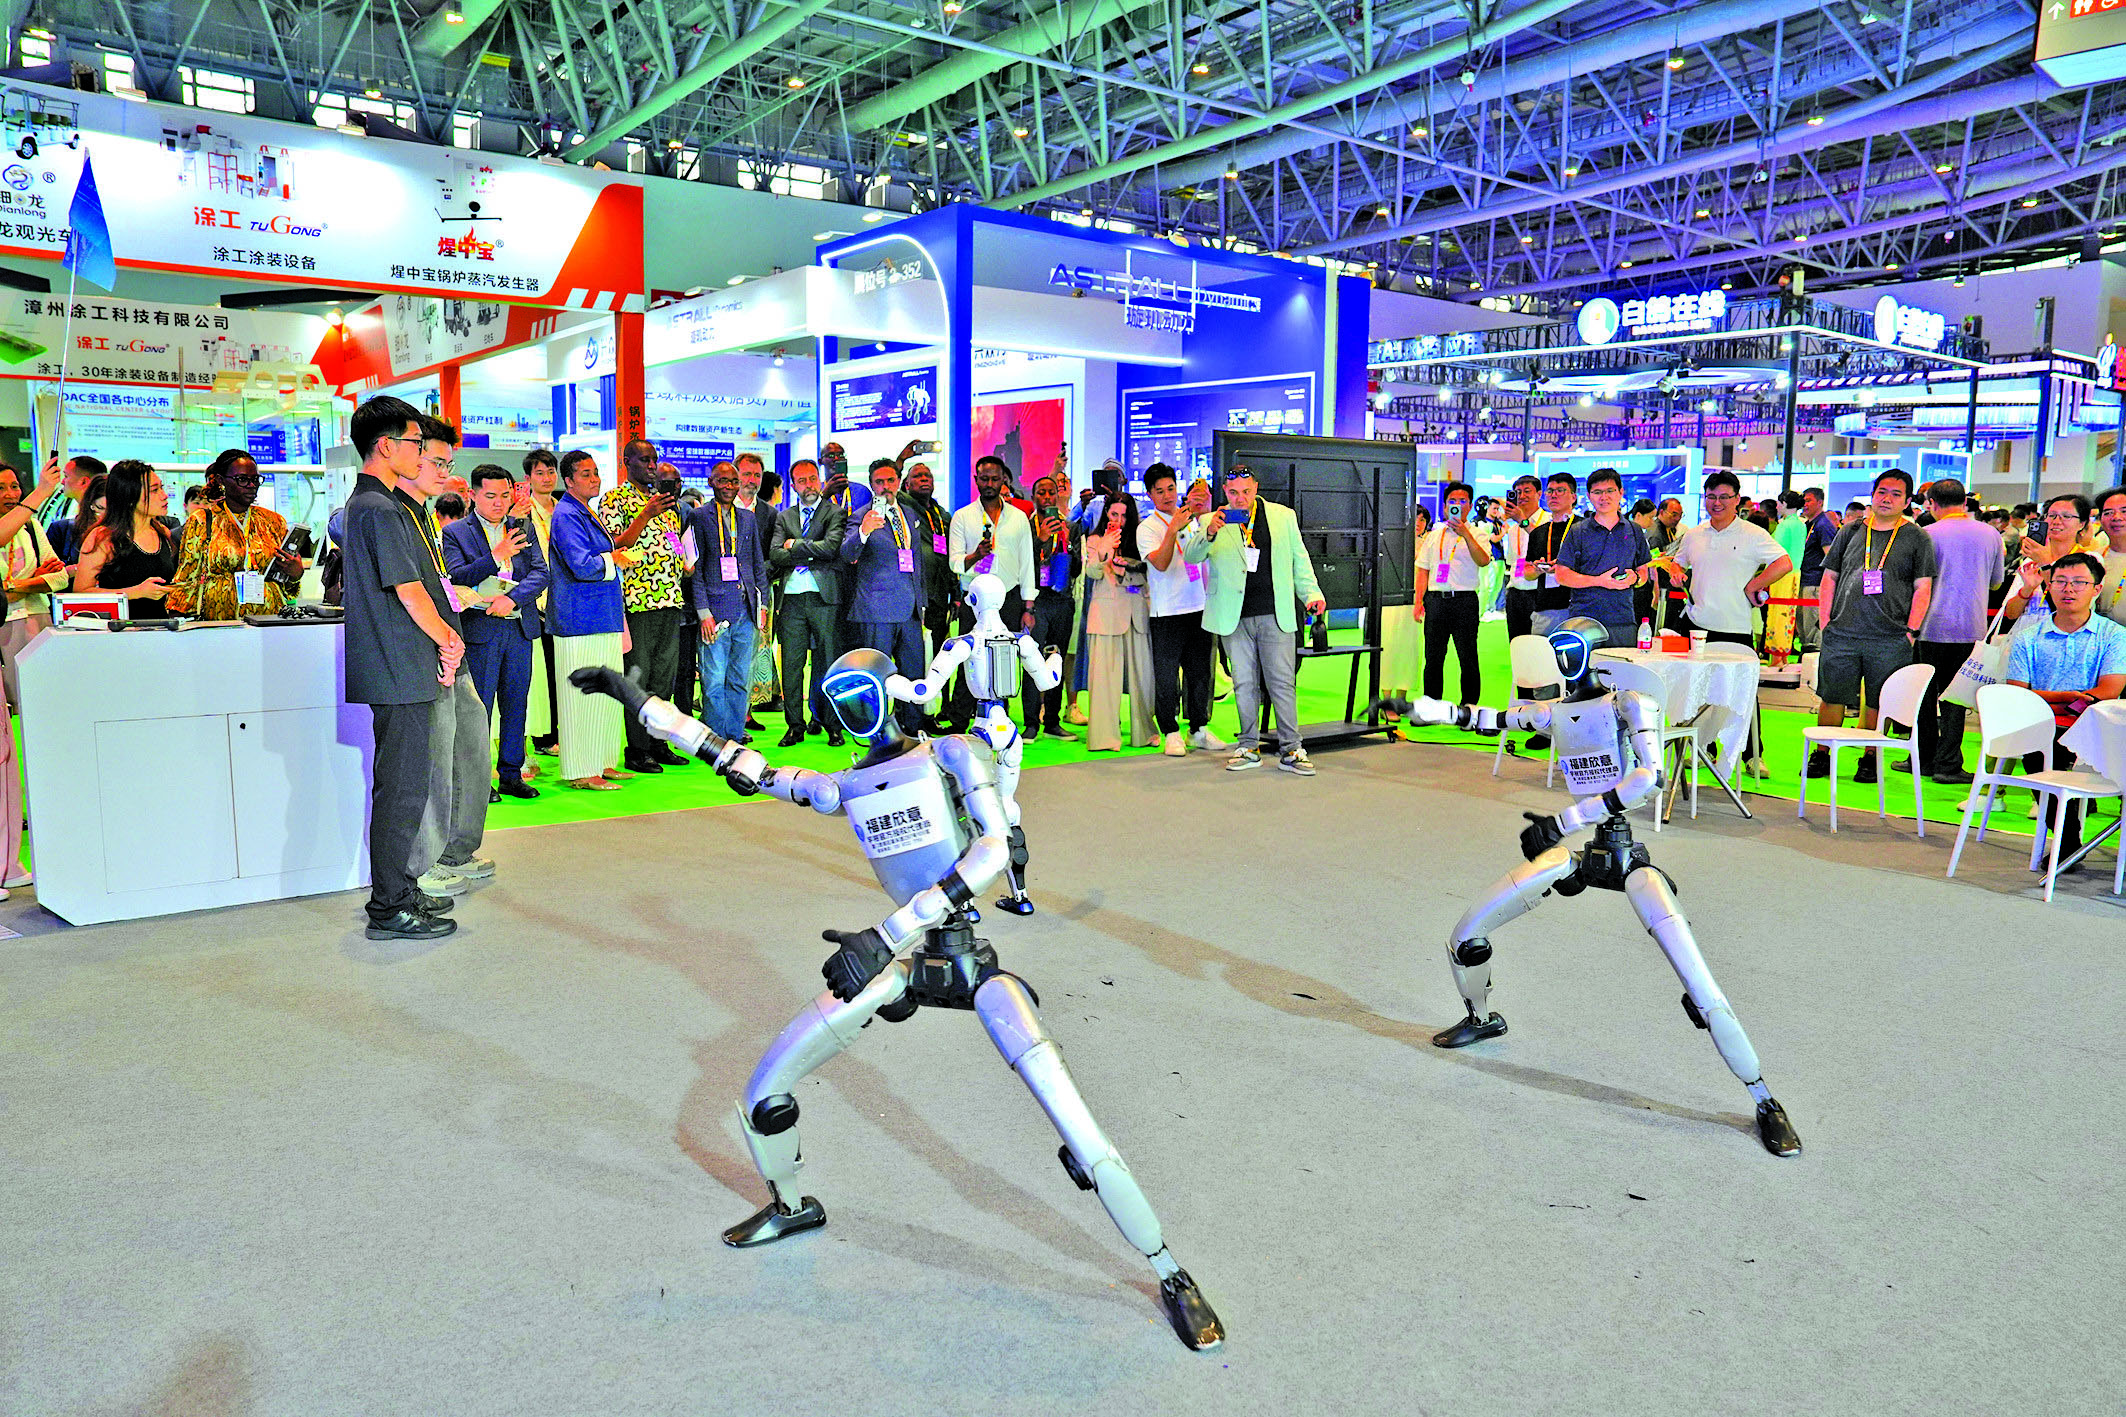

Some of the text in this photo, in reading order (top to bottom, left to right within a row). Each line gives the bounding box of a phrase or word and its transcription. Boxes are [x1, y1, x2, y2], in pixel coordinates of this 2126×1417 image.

[194, 206, 241, 229] 涂工
[213, 246, 316, 270] 涂工涂装设备
[1048, 263, 1191, 304] ASTRALL
[24, 299, 230, 330] 漳州涂工科技有限公司
[76, 336, 110, 351] 涂工
[866, 805, 923, 834] 福建欣意
